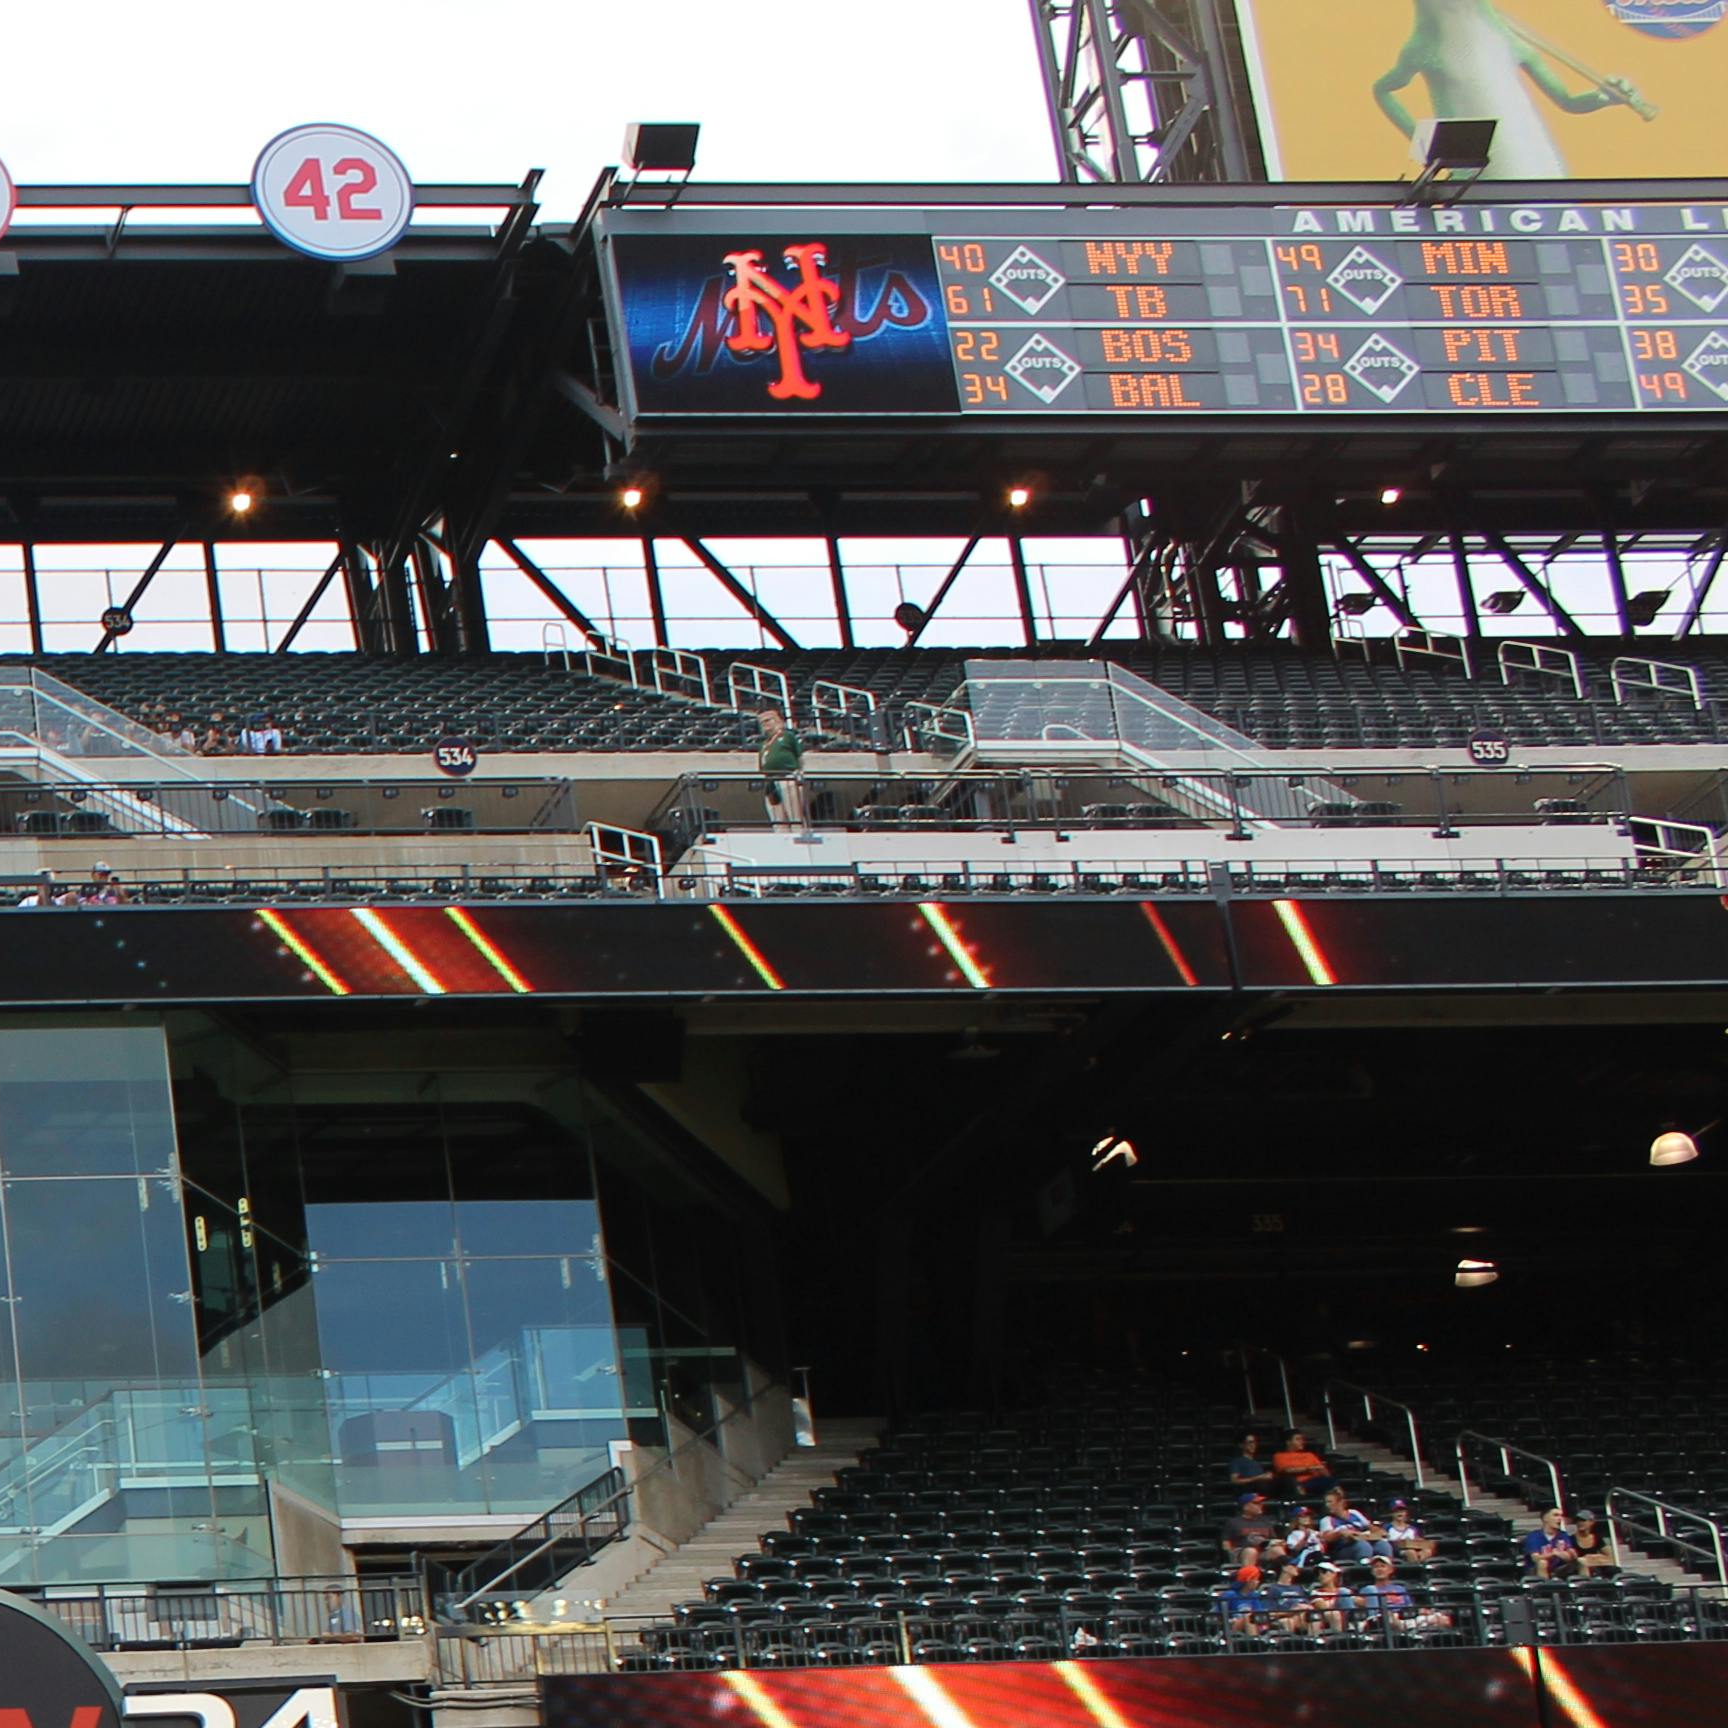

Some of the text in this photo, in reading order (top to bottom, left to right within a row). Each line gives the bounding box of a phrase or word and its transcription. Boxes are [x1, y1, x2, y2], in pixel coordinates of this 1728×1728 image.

[282, 157, 383, 222] 42
[1292, 208, 1635, 234] AMERICAN
[939, 243, 986, 273] 40
[1085, 241, 1175, 275] NYY
[1277, 243, 1322, 272] 49
[1420, 241, 1509, 275] MIN
[1614, 243, 1660, 273] 30
[1680, 266, 1721, 279] OUTS
[1004, 268, 1047, 280] OUTS
[1342, 268, 1384, 280] OUTS
[947, 285, 993, 315] 61
[1105, 284, 1168, 319] TB
[1286, 285, 1332, 313] 71
[1430, 284, 1522, 318] TOR
[1624, 285, 1670, 314] 35
[956, 331, 1000, 361] 22
[1100, 329, 1193, 363] BOS
[1294, 332, 1339, 361] 34
[1441, 329, 1521, 362] PIT
[1632, 330, 1677, 360] 38
[1021, 357, 1063, 369] OUTS
[1359, 356, 1401, 368] OUTS
[1698, 354, 1728, 367] OUT
[962, 374, 1009, 404] 34
[1109, 374, 1201, 407] BAL
[1303, 372, 1348, 403] 28
[1448, 372, 1540, 407] CLE
[1639, 371, 1687, 401] 49
[438, 747, 474, 766] 534
[1471, 741, 1507, 759] 535
